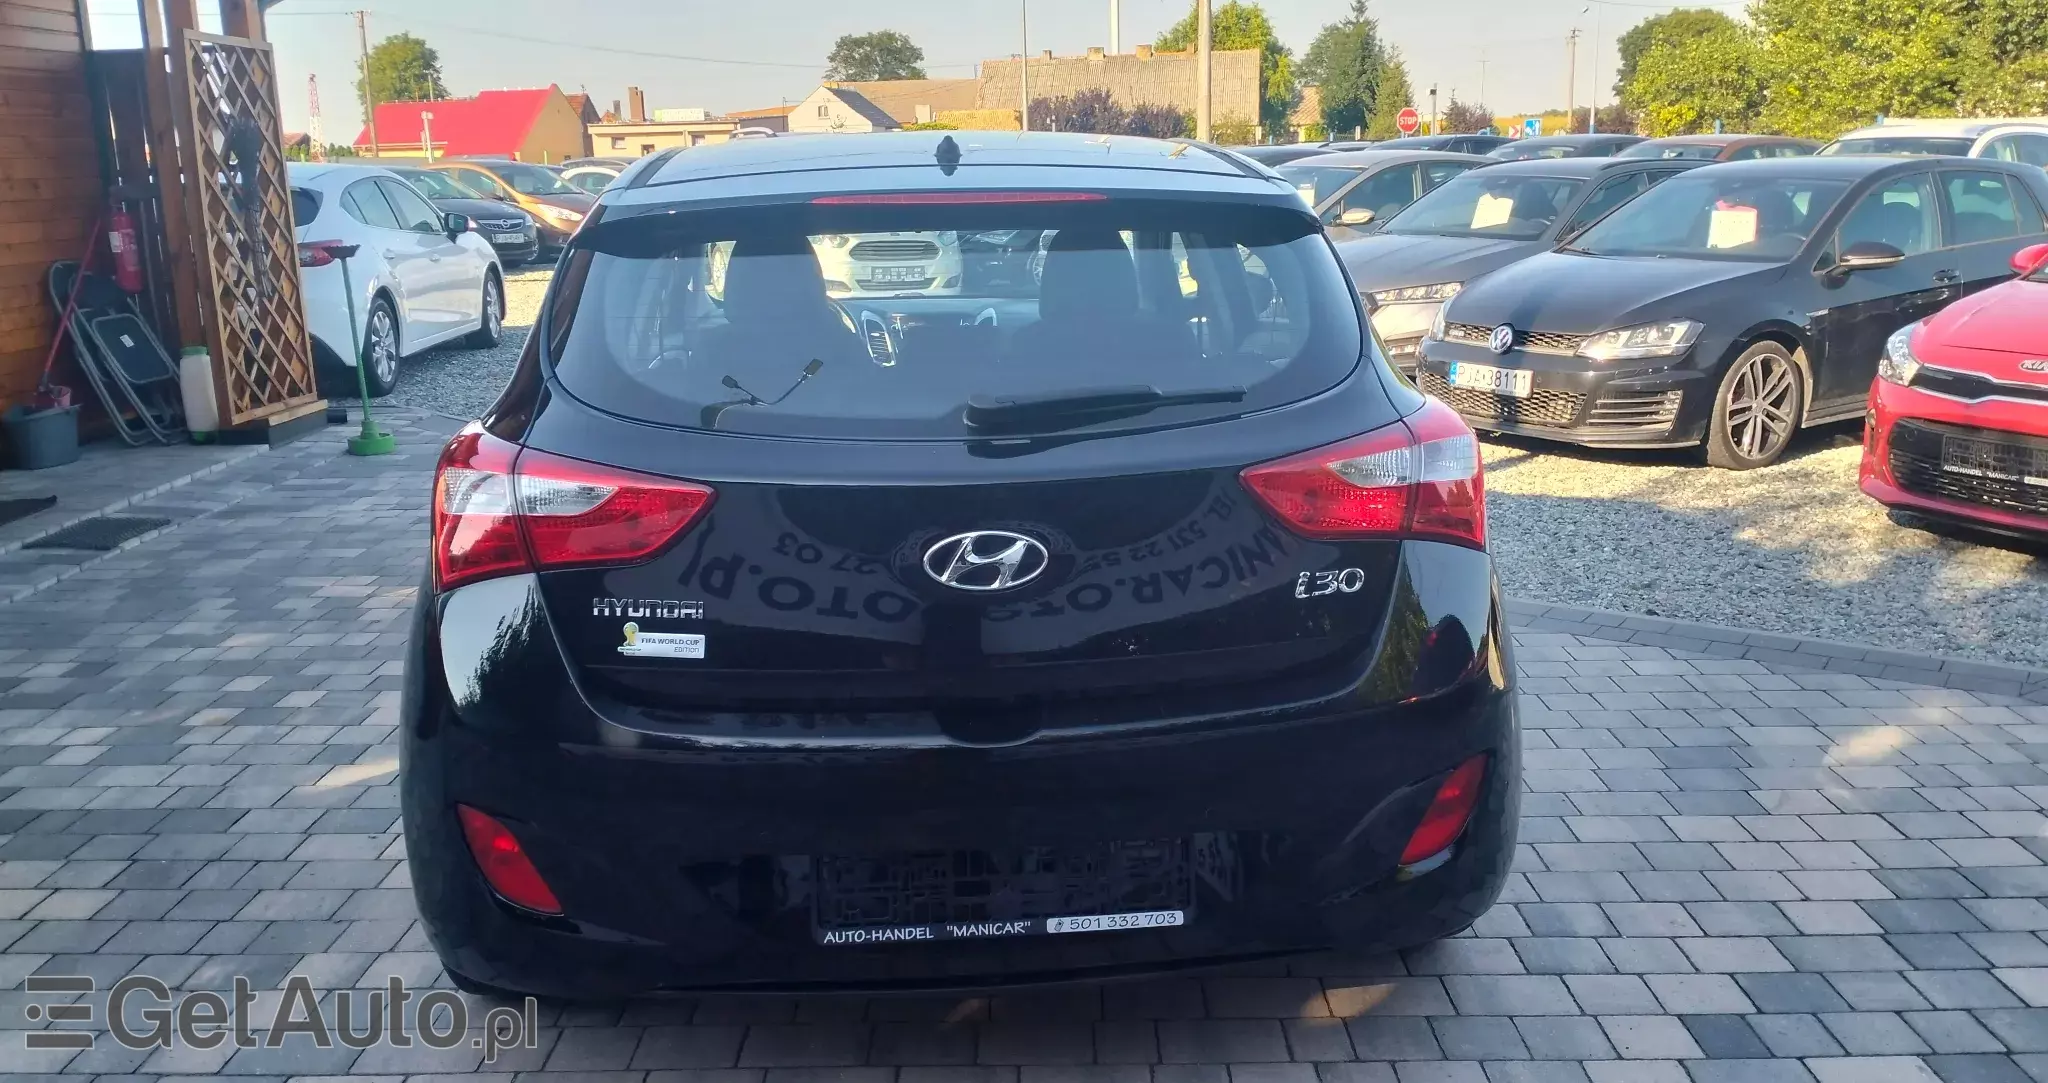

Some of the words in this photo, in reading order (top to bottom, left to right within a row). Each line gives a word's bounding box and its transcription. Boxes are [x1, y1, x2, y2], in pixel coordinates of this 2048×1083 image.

[1399, 116, 1417, 125] STOP
[2022, 359, 2048, 371] KIA
[1487, 369, 1527, 391] 38111
[1943, 464, 1983, 477] AUTO-HANDEL
[1295, 567, 1365, 599] i30
[593, 597, 704, 619] HYUNDAI
[674, 646, 700, 654] EDITION
[823, 927, 934, 944] AUTO-HANDEL
[946, 921, 1031, 937] "MANICAR"
[1070, 917, 1101, 930] 501
[1107, 915, 1140, 928] 332
[1144, 912, 1177, 925] 703
